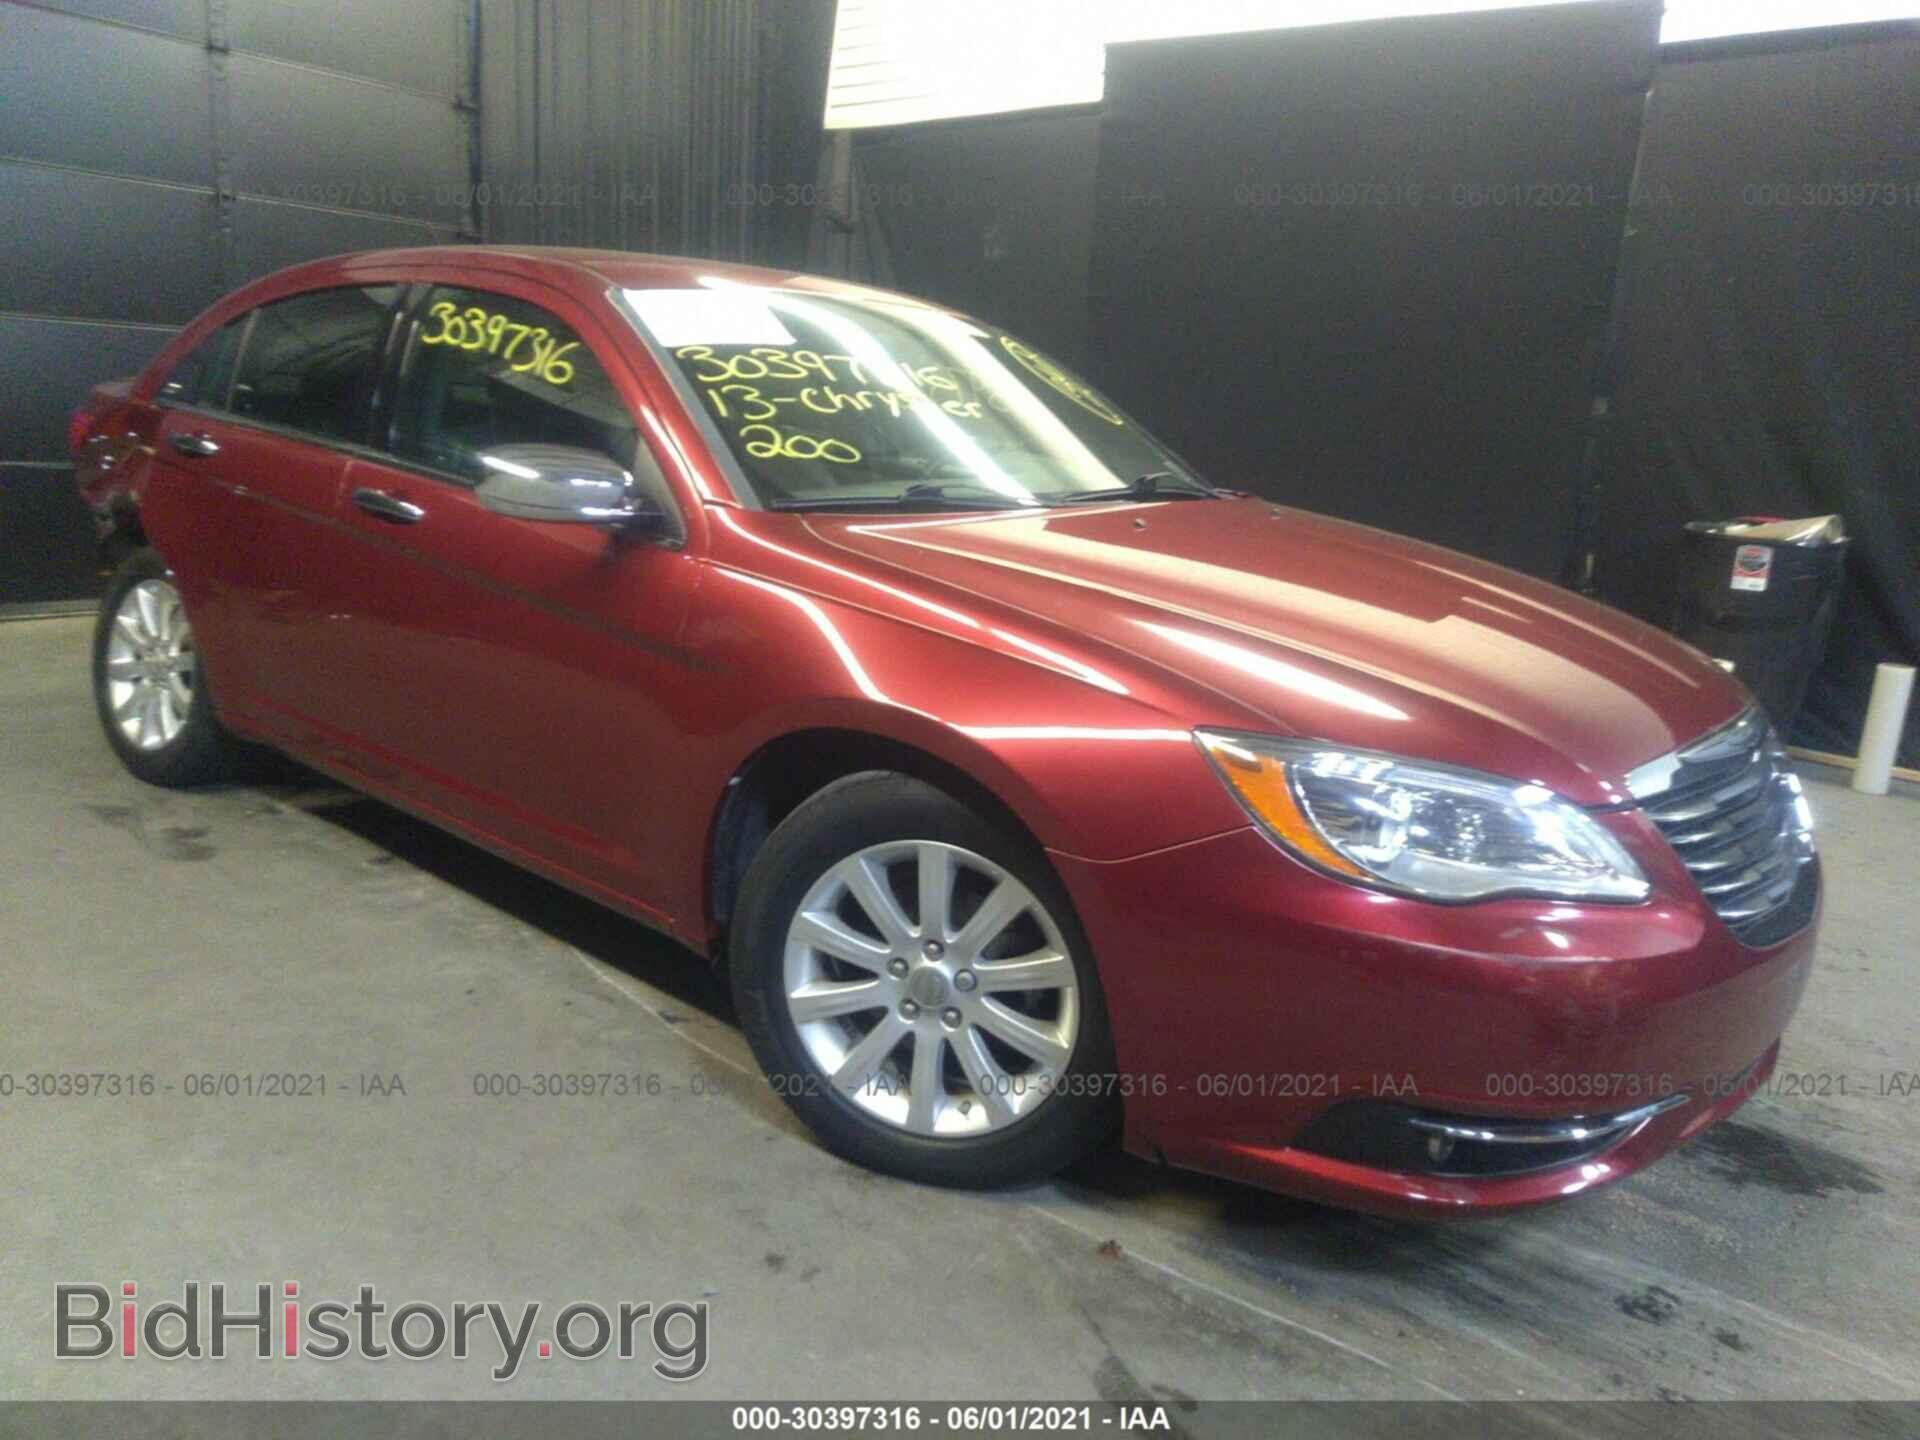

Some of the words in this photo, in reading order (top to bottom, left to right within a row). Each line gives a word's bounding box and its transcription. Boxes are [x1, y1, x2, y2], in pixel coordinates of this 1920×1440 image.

[421, 301, 582, 386] 30397316
[676, 345, 959, 391] 3039716
[739, 424, 862, 464] 200
